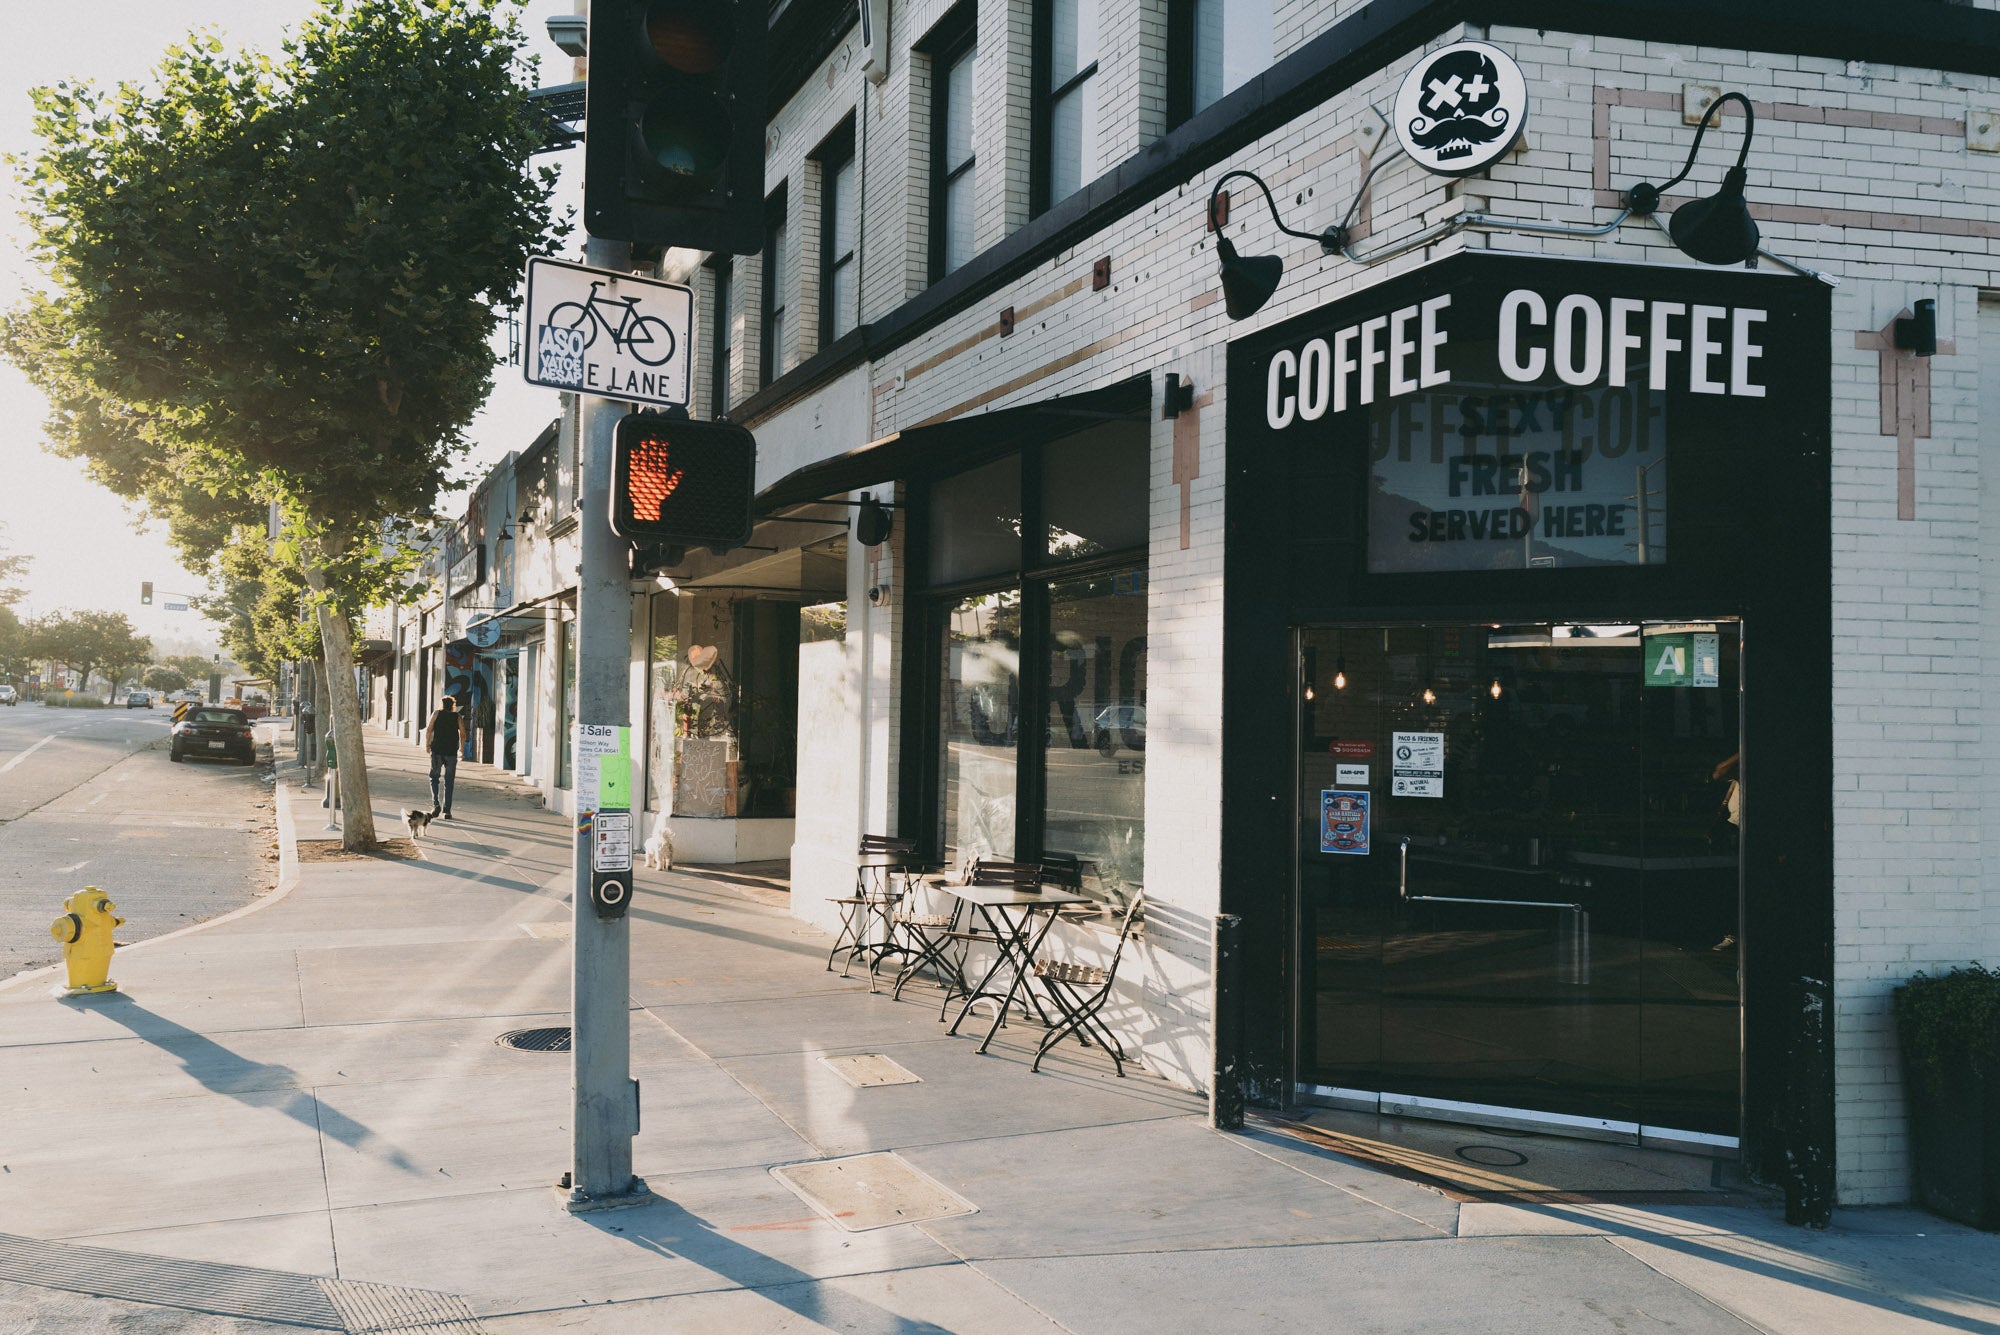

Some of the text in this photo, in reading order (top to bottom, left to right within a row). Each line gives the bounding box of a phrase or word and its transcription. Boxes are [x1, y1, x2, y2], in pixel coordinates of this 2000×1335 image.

[540, 326, 584, 359] ASO
[1266, 294, 1451, 430] COFFEE
[1498, 289, 1768, 398] COFFEE
[610, 366, 670, 398] LANE
[1458, 390, 1574, 437] SEXY
[1448, 449, 1583, 497] FRESH
[1408, 503, 1626, 543] SERVED HERE
[1653, 645, 1684, 675] A
[587, 725, 612, 736] Sale
